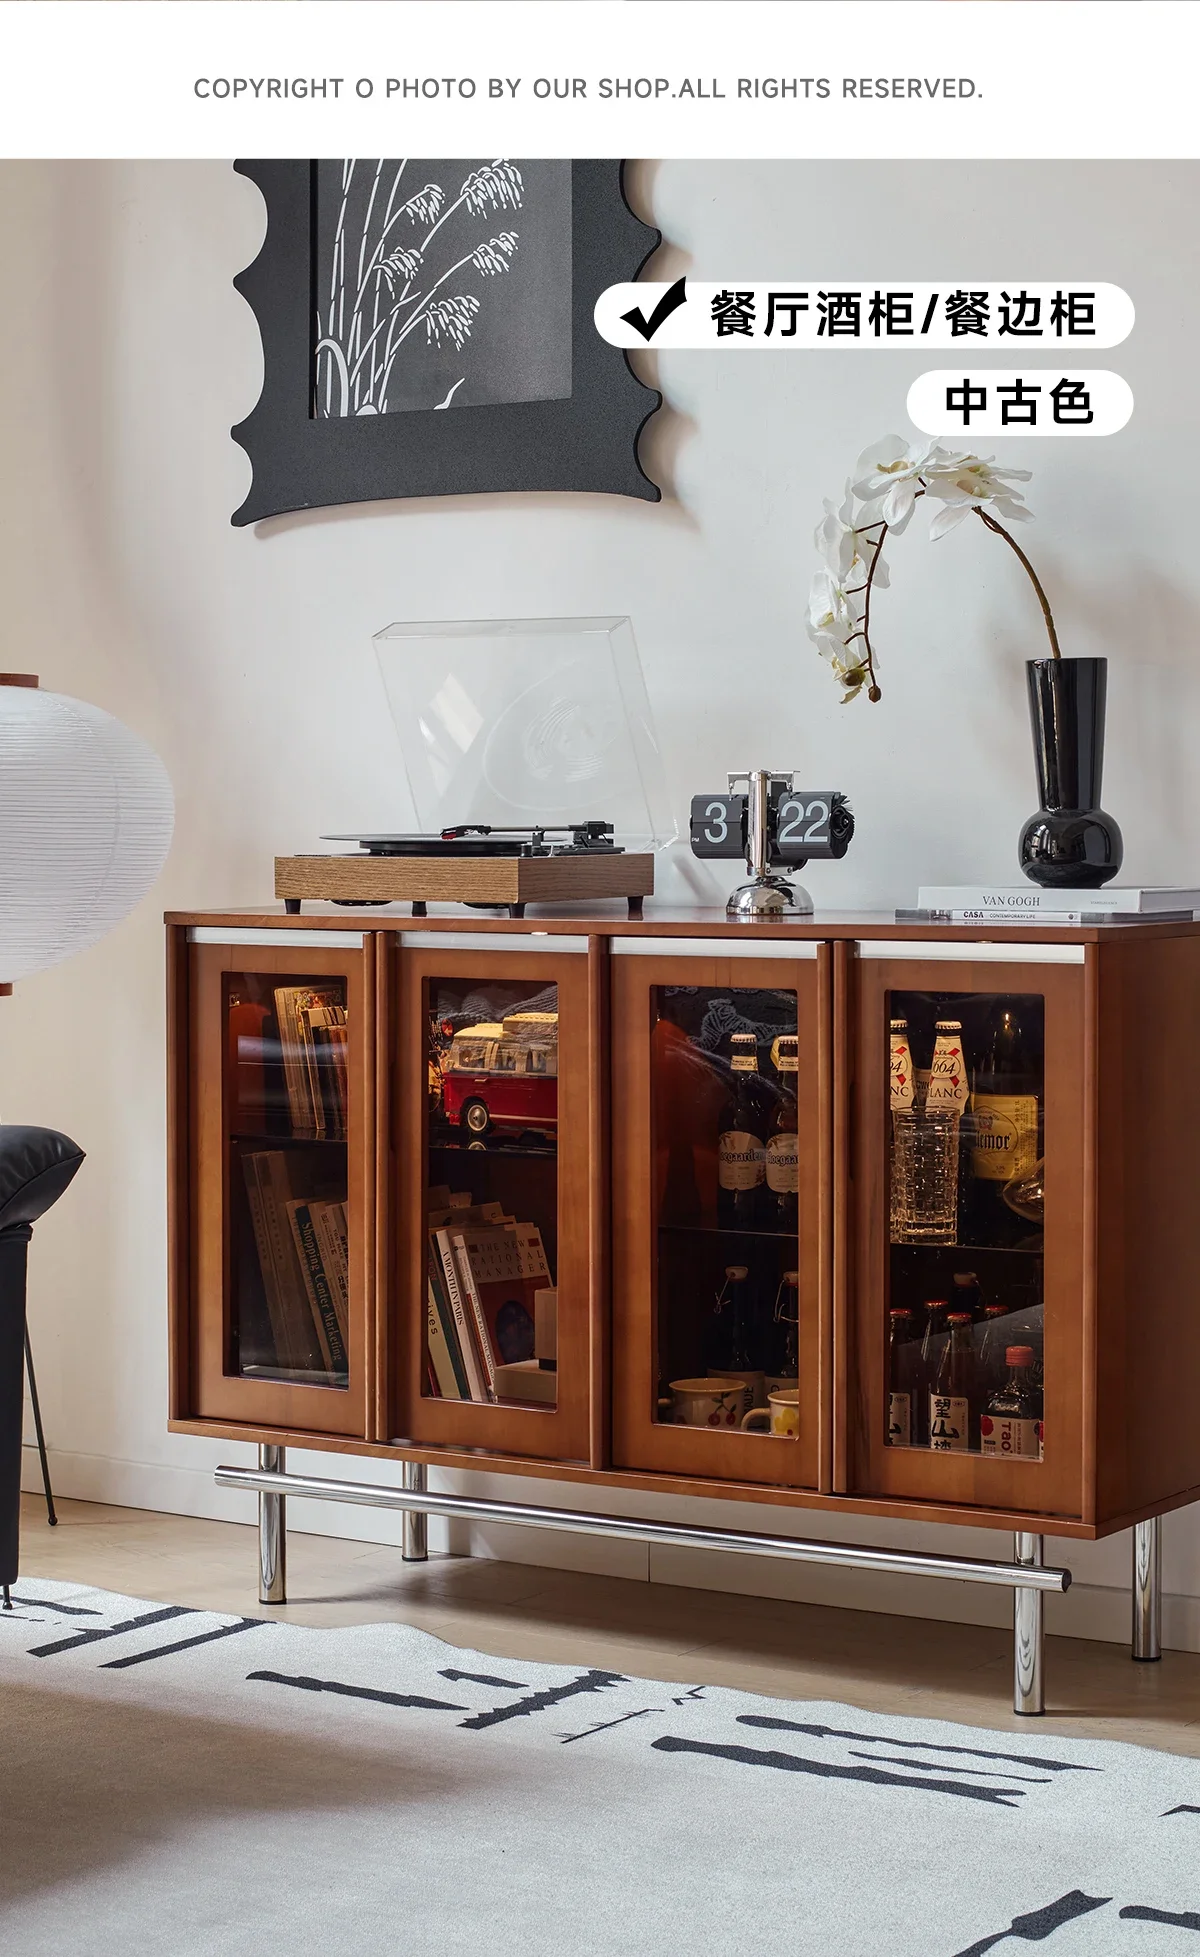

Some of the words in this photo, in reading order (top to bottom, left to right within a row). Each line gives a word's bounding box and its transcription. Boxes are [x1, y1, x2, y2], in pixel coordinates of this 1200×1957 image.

[704, 802, 728, 843] 3
[779, 800, 829, 843] 22
[983, 896, 1005, 905] VAN
[1007, 896, 1040, 906] GOGH
[504, 1239, 526, 1249] NEW
[474, 1262, 546, 1279] MANAGER
[302, 1221, 322, 1271] Shopping
[314, 1273, 330, 1309] Center
[323, 1311, 343, 1360] Marketing
[444, 1258, 456, 1289] MONTH
[453, 1301, 463, 1326] PARIS
